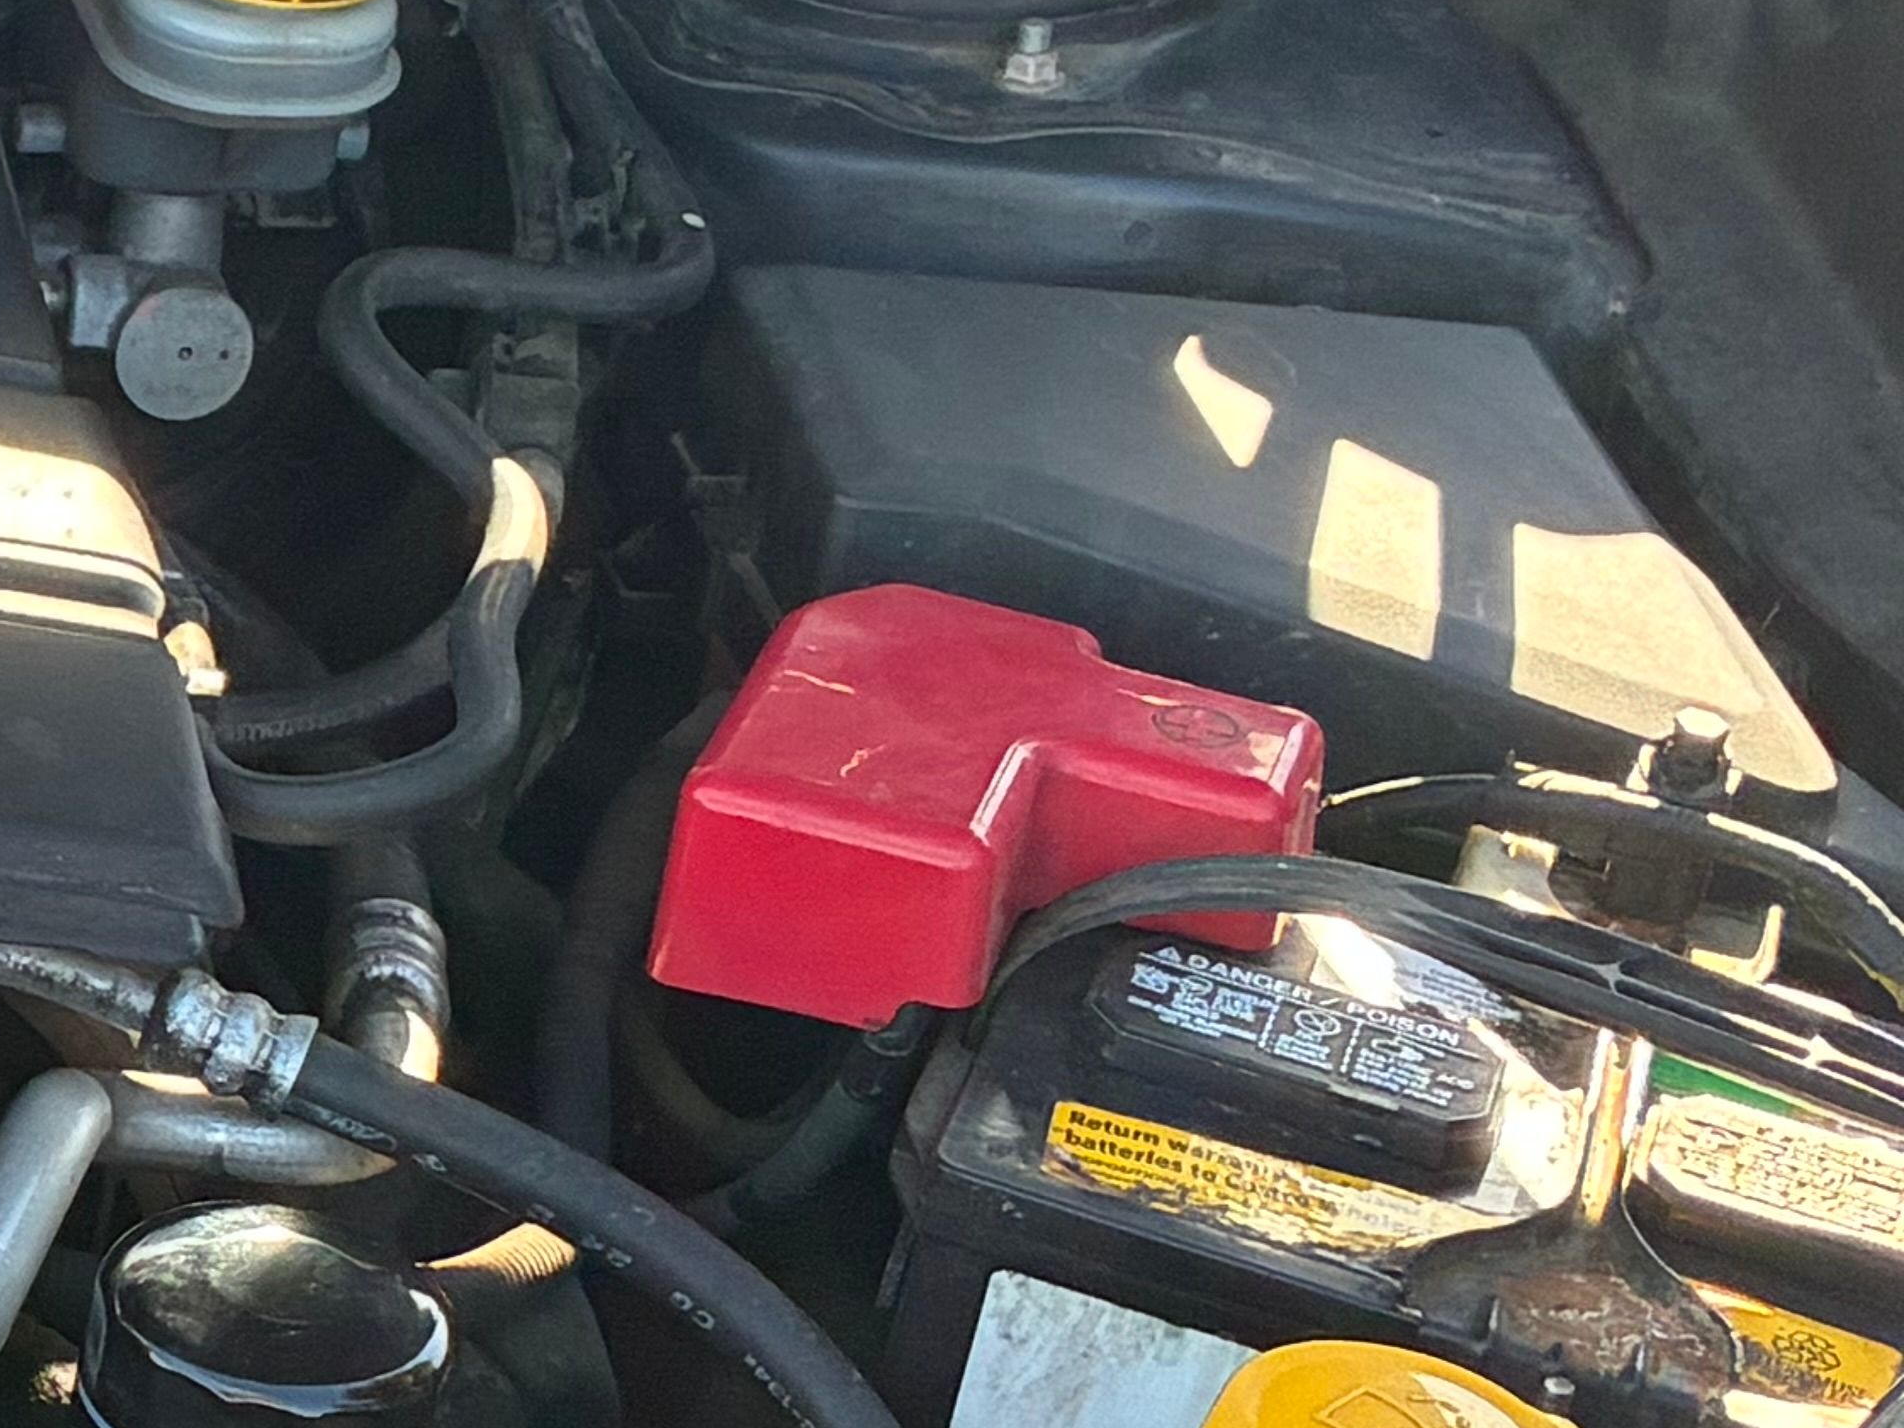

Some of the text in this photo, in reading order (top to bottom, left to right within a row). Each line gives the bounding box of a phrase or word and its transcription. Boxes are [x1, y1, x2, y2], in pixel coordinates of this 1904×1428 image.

[1187, 953, 1313, 1003] DANGER
[1346, 1001, 1463, 1047] POISON
[1063, 1128, 1184, 1174] batteries
[1189, 1162, 1219, 1184] to
[1066, 1109, 1162, 1148] Return
